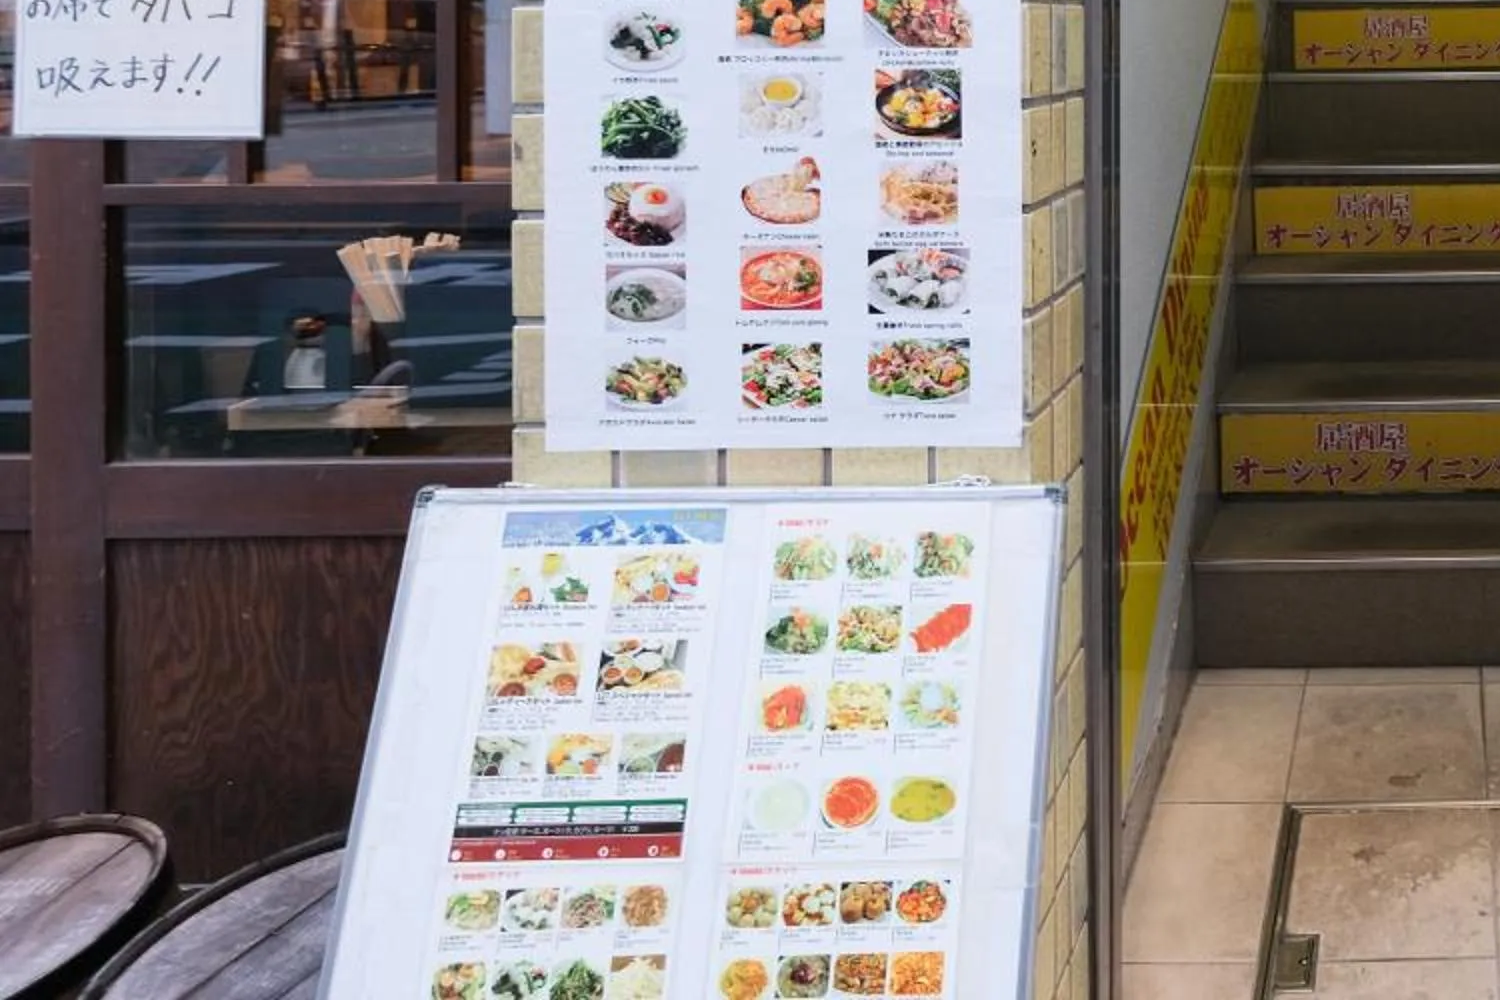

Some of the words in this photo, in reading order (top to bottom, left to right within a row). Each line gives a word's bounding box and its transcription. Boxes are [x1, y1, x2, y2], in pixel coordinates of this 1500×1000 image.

[36, 53, 222, 98] 吸えます!!
[1336, 193, 1411, 220] 居酒屋
[1316, 422, 1408, 452] 居酒屋
